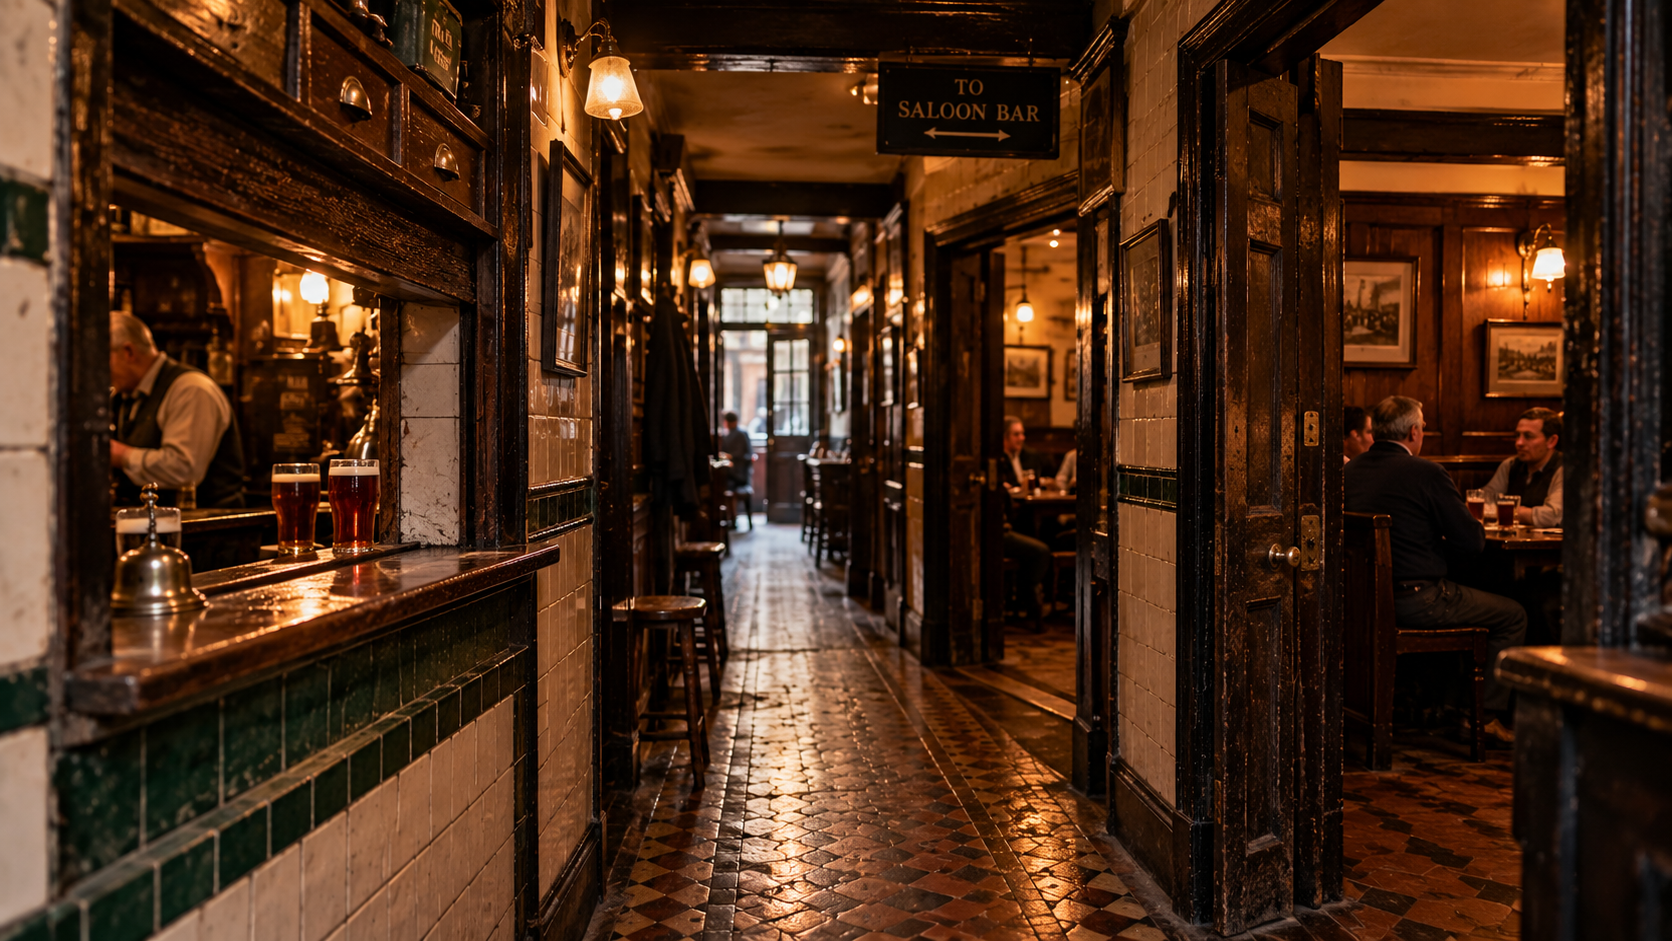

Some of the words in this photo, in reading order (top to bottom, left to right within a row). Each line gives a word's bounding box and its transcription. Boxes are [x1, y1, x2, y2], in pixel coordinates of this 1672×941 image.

[954, 78, 984, 96] TO
[898, 100, 987, 121] SALOON
[996, 103, 1041, 122] BAR
